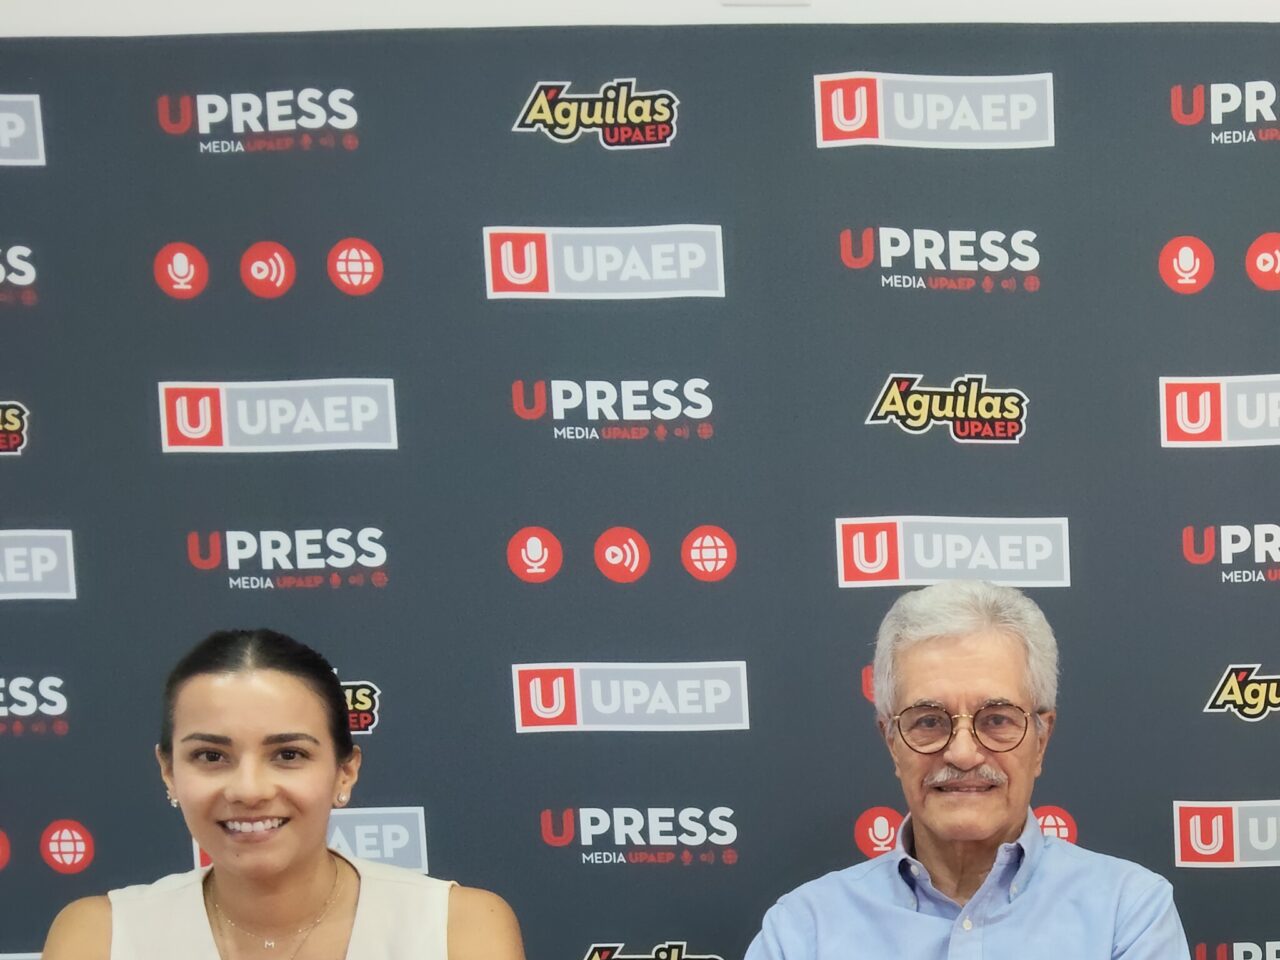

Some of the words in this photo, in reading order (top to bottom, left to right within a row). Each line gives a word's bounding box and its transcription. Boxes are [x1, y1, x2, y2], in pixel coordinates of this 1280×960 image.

[158, 88, 358, 135] UPRESS
[528, 84, 671, 141] Águilas
[831, 87, 867, 132] U
[894, 93, 1036, 130] UPAEP
[200, 141, 244, 152] MEDIA
[604, 123, 671, 144] UPAEP
[1211, 130, 1256, 144] MEDIA
[501, 241, 537, 284] U
[564, 243, 706, 281] UPAEP
[839, 227, 1040, 272] UPRESS
[882, 275, 926, 288] MEDIA
[928, 277, 976, 290] UPAEP
[176, 396, 211, 438] U
[238, 397, 378, 434] UPAEP
[512, 378, 712, 420] UPRESS
[880, 380, 1020, 428] Águilas
[1176, 391, 1211, 434] U
[554, 427, 599, 439] MEDIA
[602, 426, 648, 439] UPAEP
[954, 418, 1020, 438] UPAEP
[187, 528, 386, 570] UPRESS
[853, 531, 888, 573] U
[914, 534, 1052, 569] UPAEP
[229, 577, 274, 588] MEDIA
[1222, 570, 1265, 582] MEDIA
[530, 677, 565, 718] U
[592, 680, 730, 713] UPAEP
[329, 825, 409, 858] AEP
[540, 807, 737, 847] UPRESS
[1190, 815, 1223, 854] U
[582, 852, 626, 863] MEDIA
[628, 852, 675, 863] UPAEP
